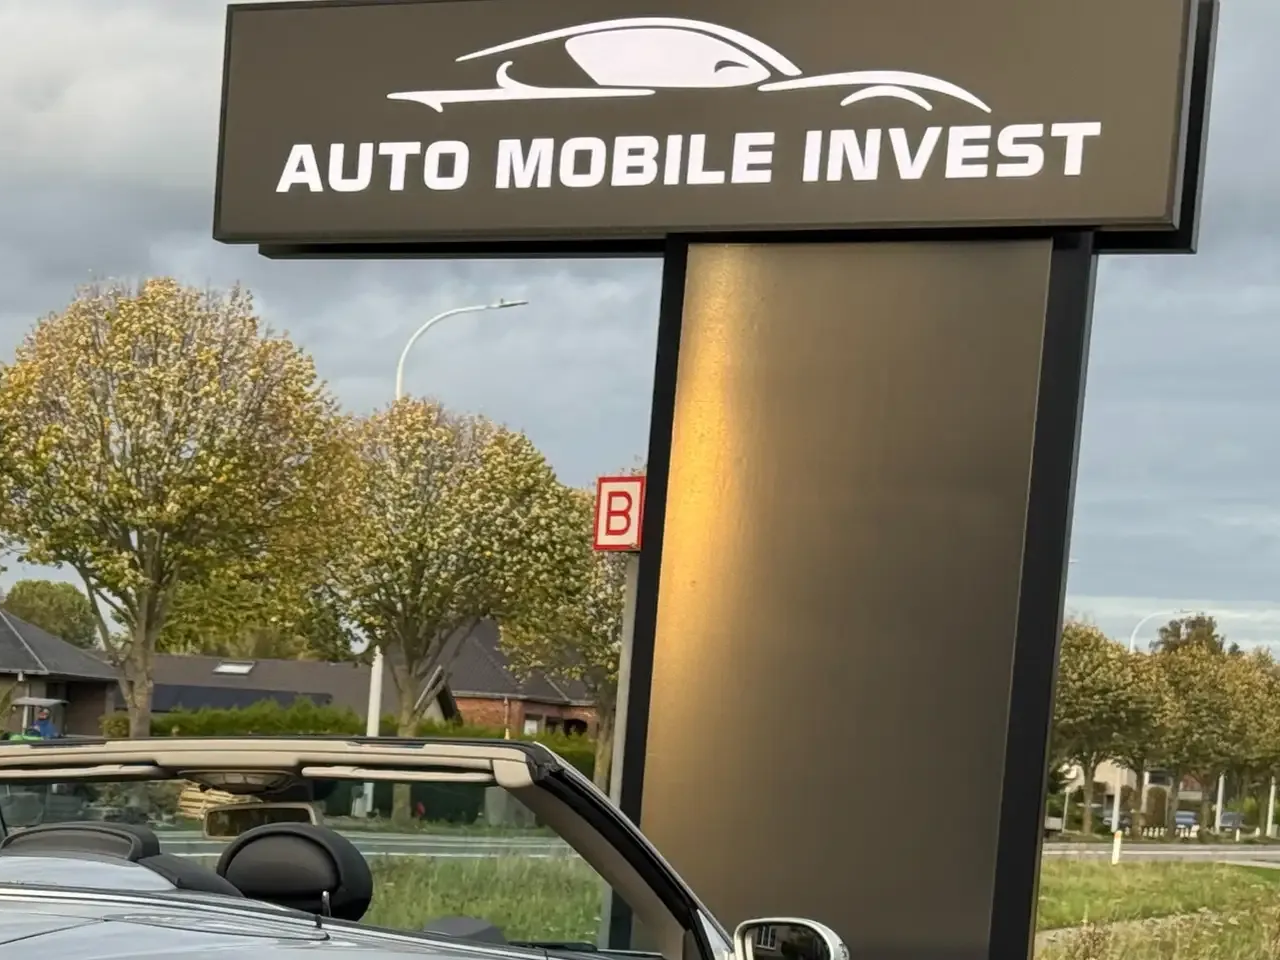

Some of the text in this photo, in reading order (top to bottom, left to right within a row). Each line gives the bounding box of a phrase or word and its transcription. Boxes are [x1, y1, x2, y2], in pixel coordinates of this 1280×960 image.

[275, 121, 1102, 193] AUTO MOBILE INVEST
[605, 491, 633, 536] B
